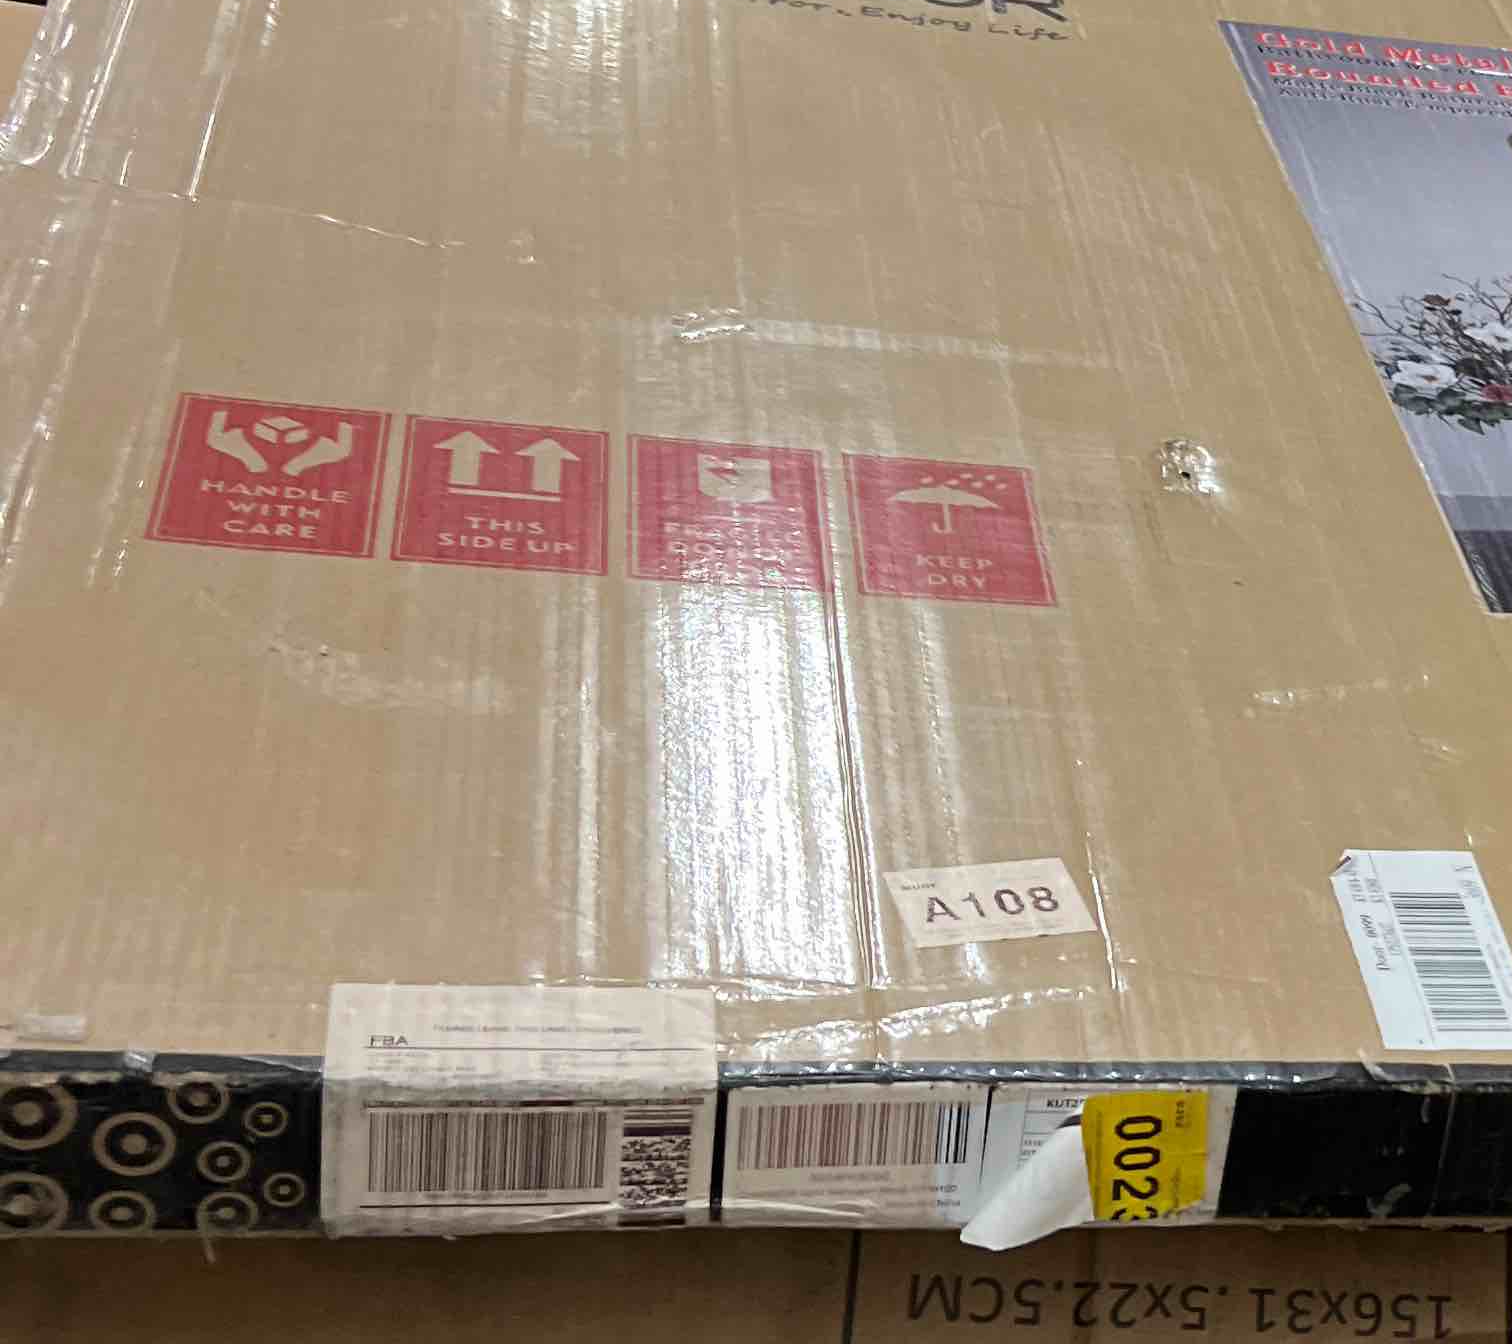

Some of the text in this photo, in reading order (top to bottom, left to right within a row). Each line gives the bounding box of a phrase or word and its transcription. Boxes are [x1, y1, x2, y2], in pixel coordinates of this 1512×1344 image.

[862, 3, 972, 33] Enjoy
[200, 479, 353, 504] HANDLE
[226, 499, 321, 519] WITH
[223, 520, 319, 539] CARE
[465, 515, 547, 535] THIS
[436, 532, 578, 555] SIDE UP
[915, 555, 994, 571] KEEP
[928, 575, 989, 590] DRY
[926, 886, 1060, 923] A108
